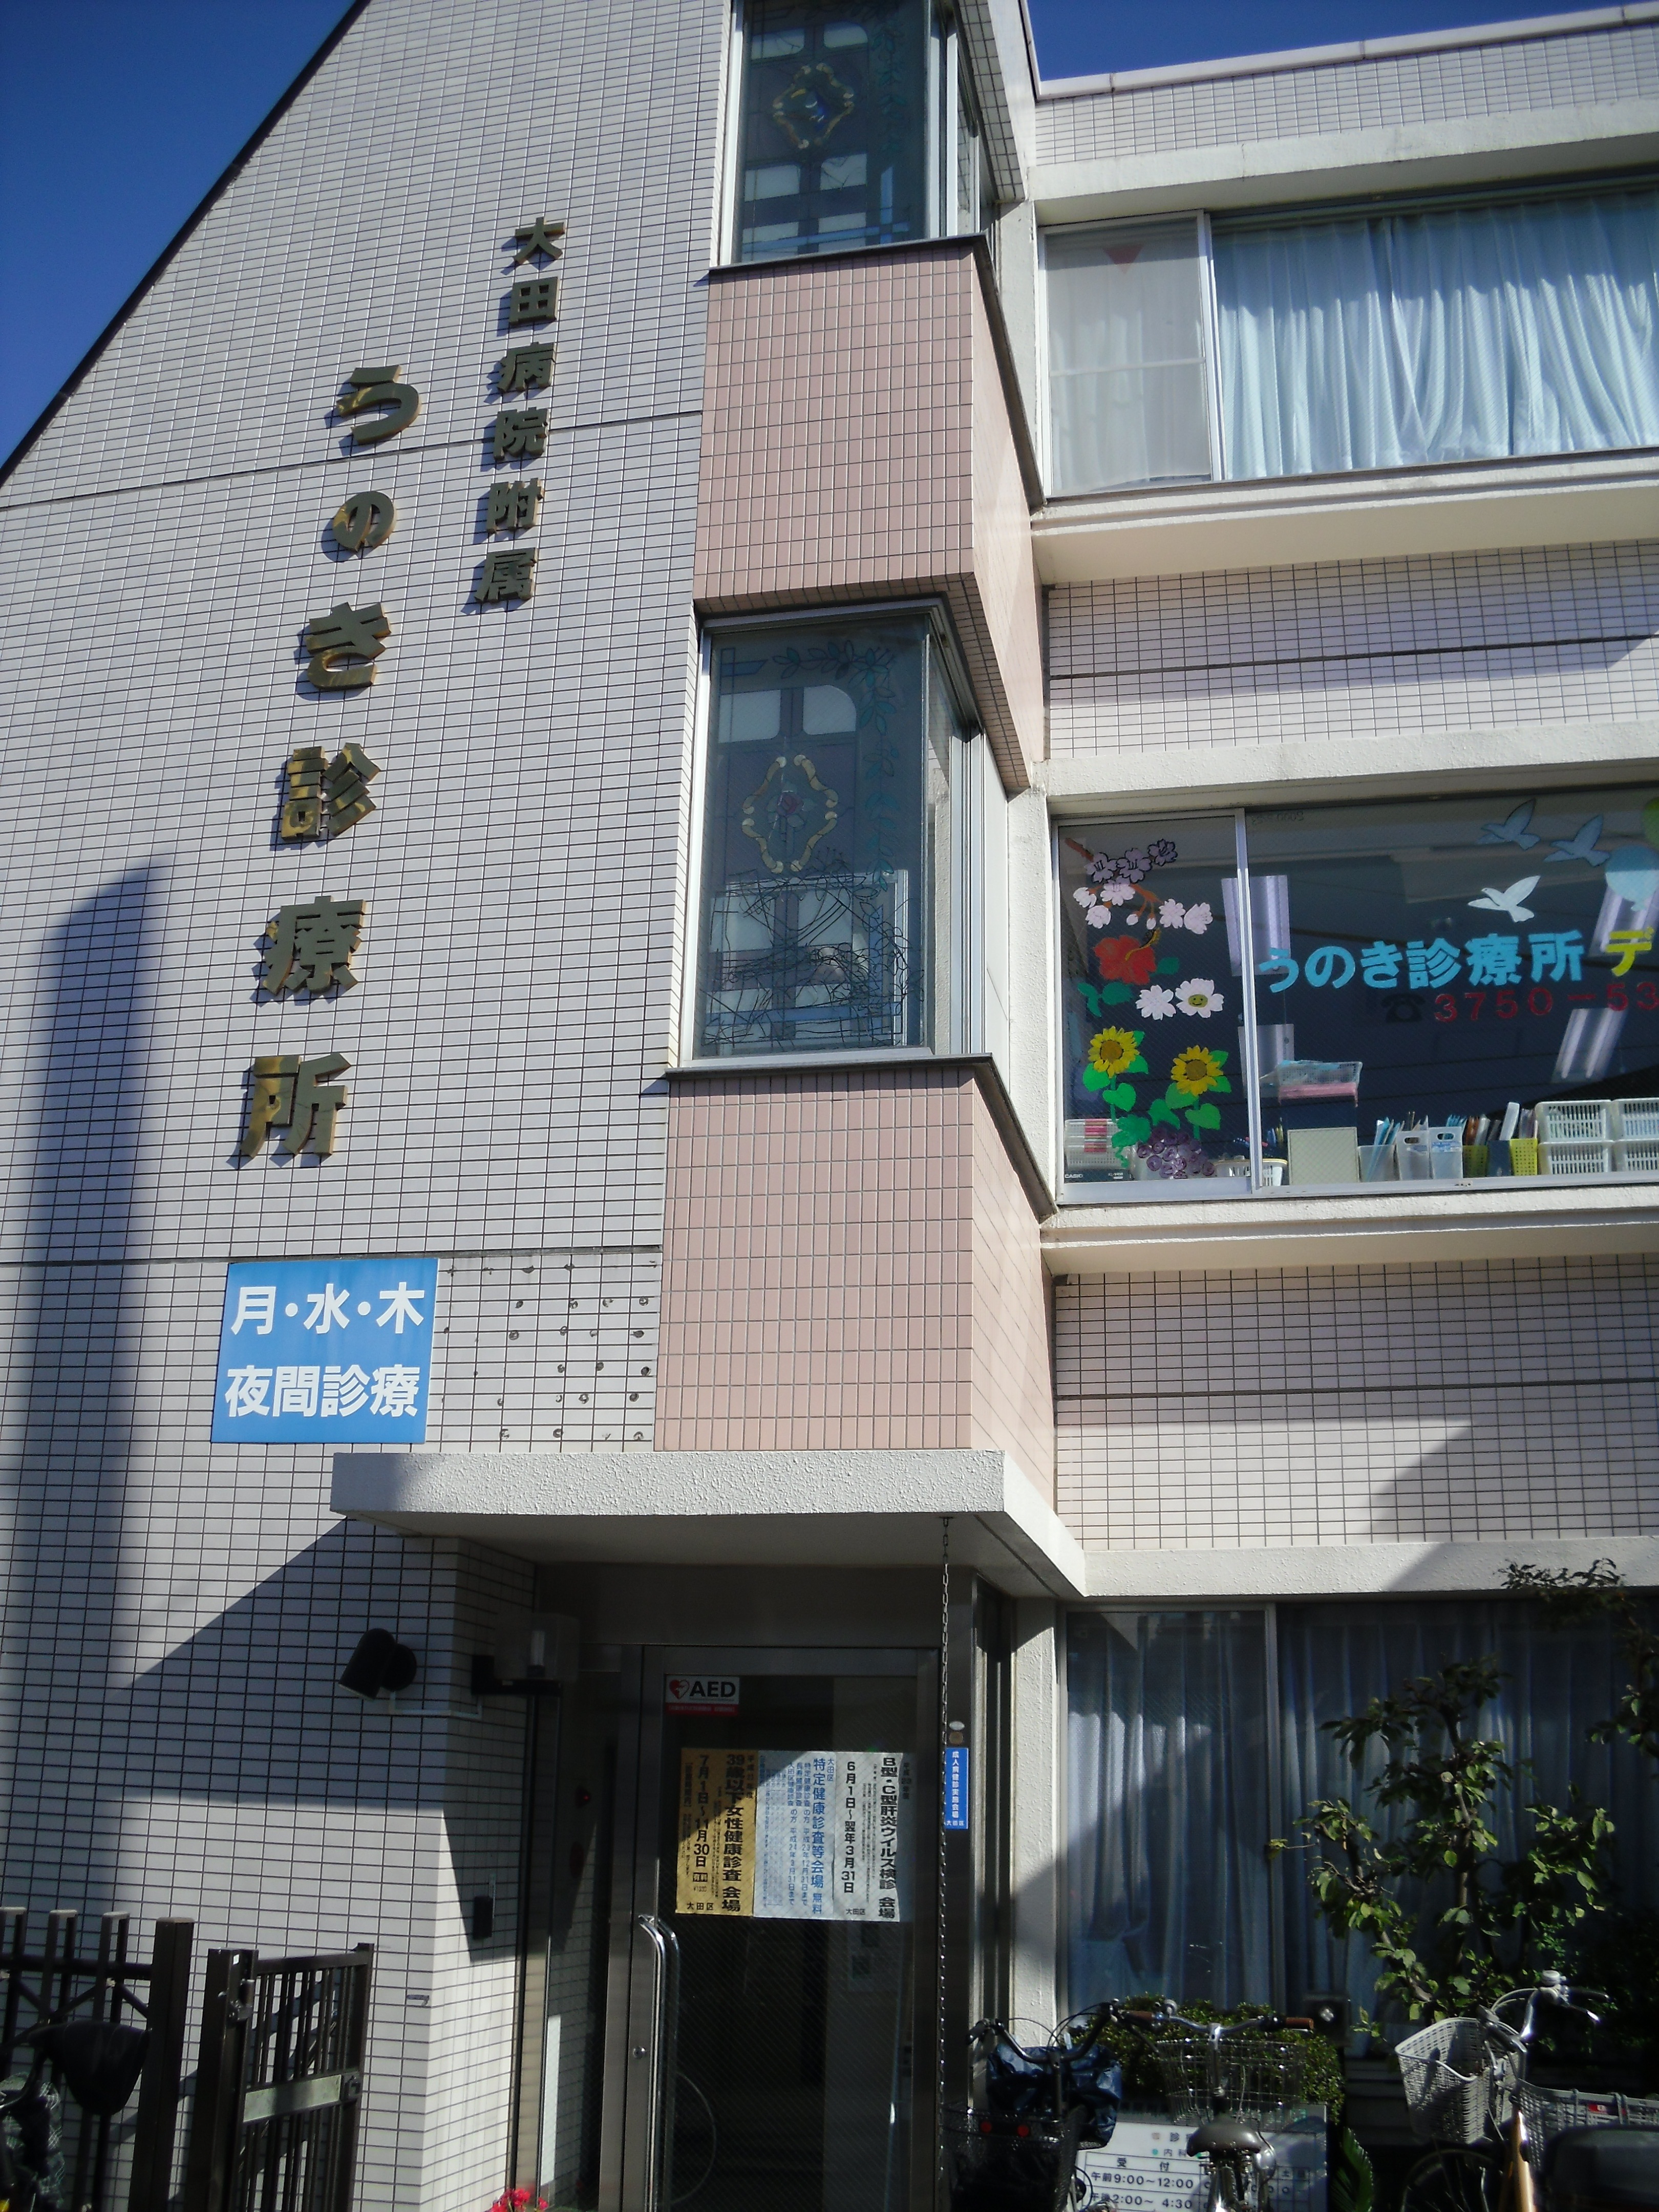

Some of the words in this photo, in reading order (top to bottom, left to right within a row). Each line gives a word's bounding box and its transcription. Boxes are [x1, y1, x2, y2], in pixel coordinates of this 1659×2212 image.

[475, 216, 566, 603] 大田病院附属
[241, 365, 421, 1157] うのき診療所
[1259, 929, 1584, 993] うのき診療所
[231, 1282, 424, 1335] 月・水・木
[225, 1365, 420, 1417] 夜間診療
[690, 1681, 736, 1697] AED
[811, 1758, 826, 1888] 特定健康診査等会場
[687, 1902, 714, 1910] 大田区
[722, 1886, 741, 1911] 会場
[878, 1897, 895, 1919] 会場
